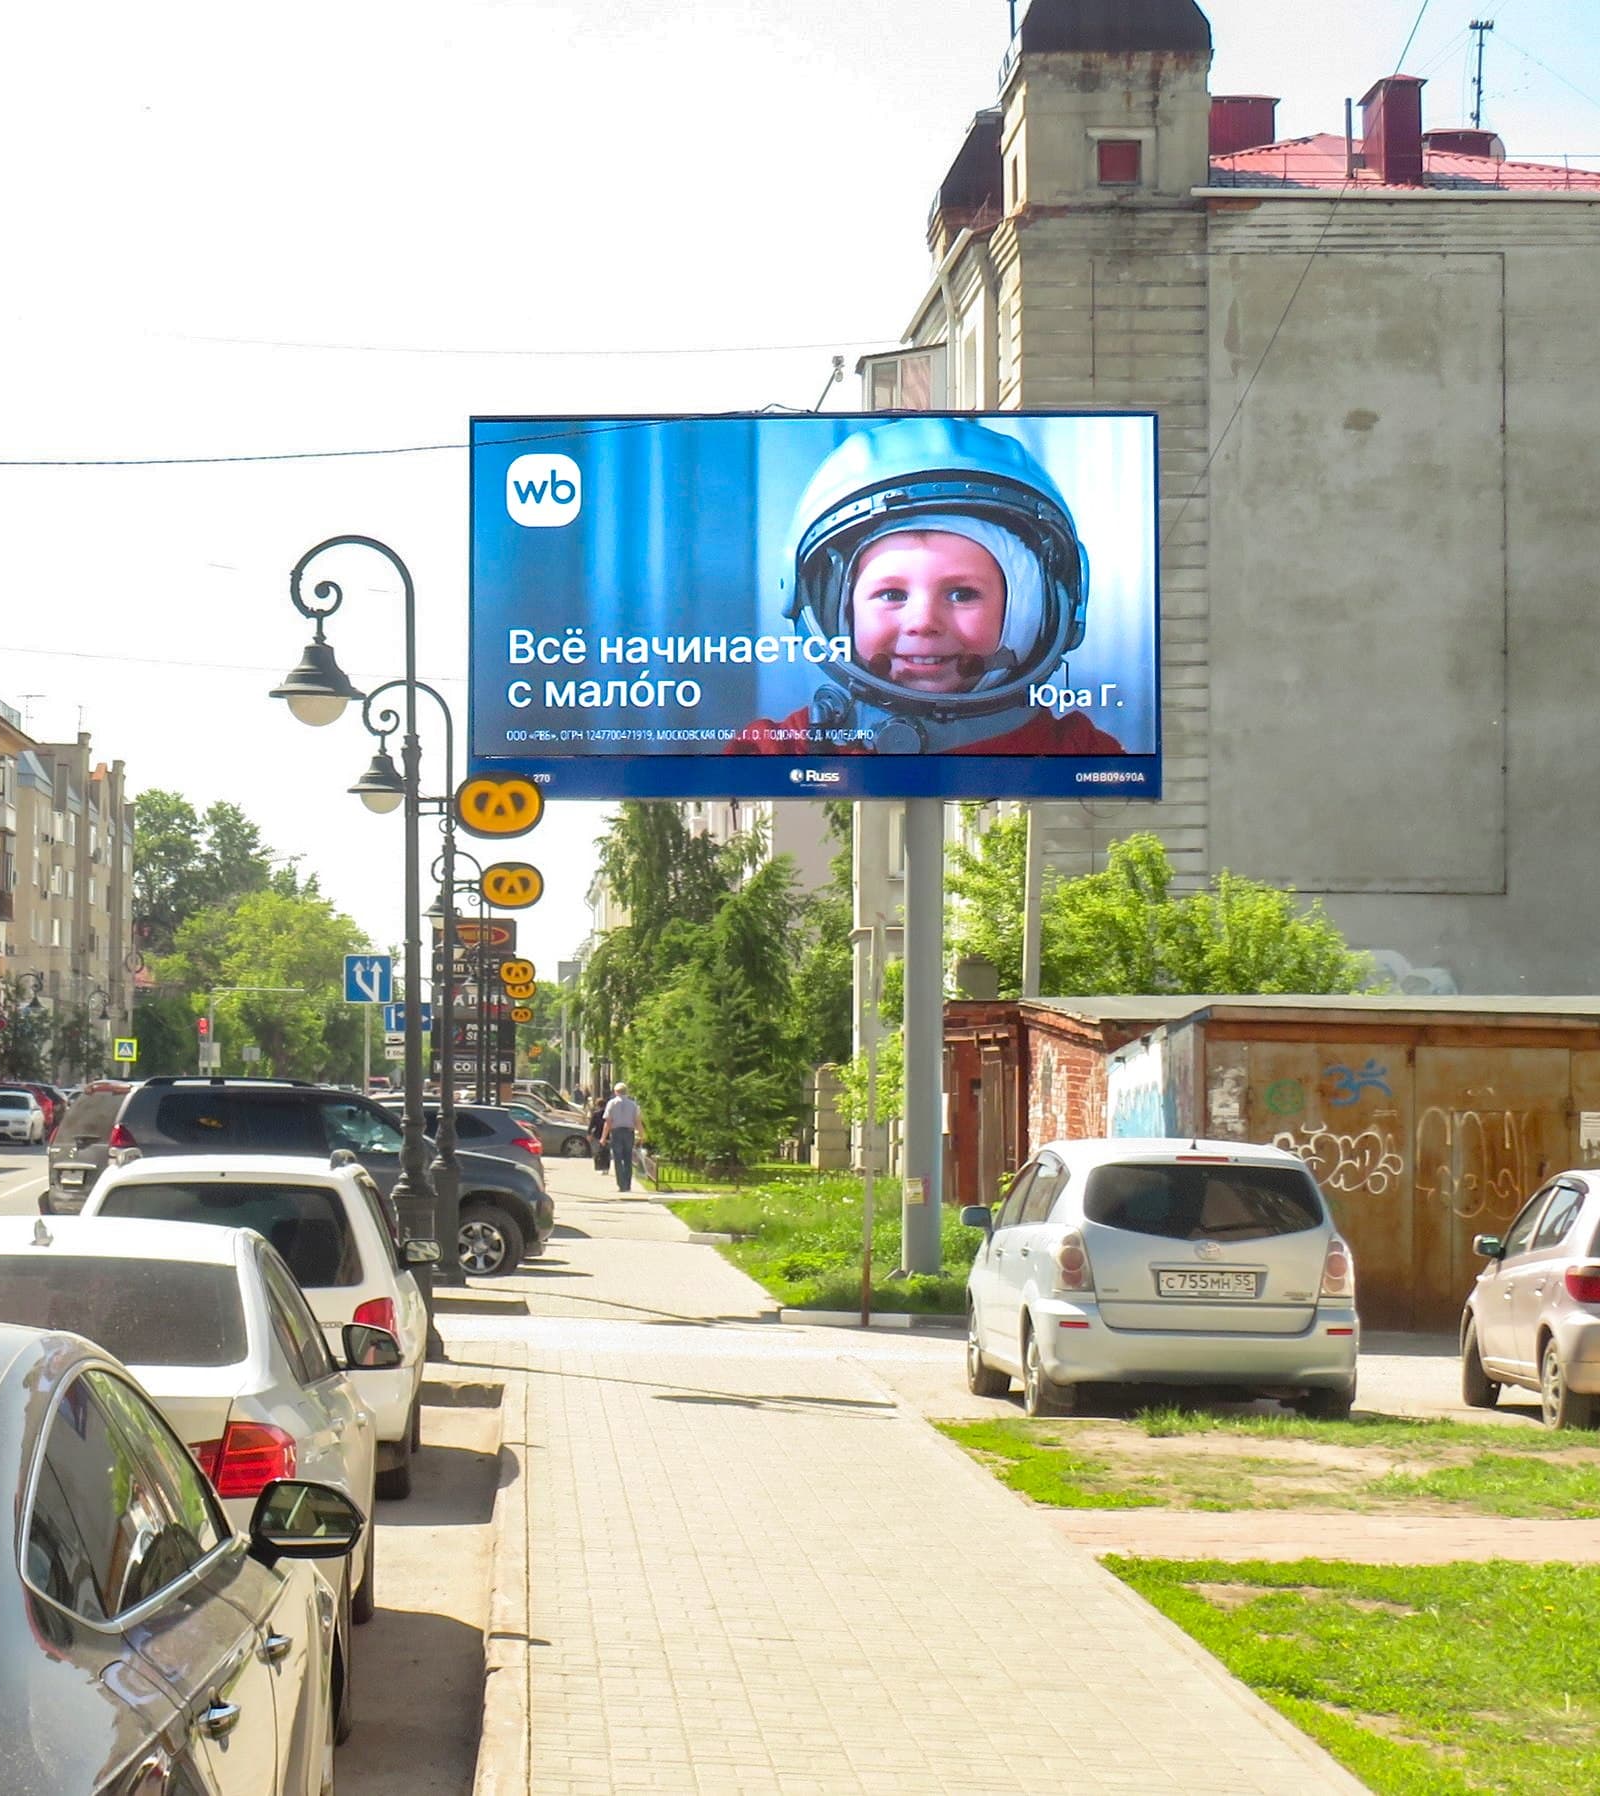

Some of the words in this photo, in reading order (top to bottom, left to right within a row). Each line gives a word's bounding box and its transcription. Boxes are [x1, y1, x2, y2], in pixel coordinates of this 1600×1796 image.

[512, 469, 576, 505] wb
[508, 627, 587, 665] Всё
[600, 635, 852, 664] начинается
[507, 680, 533, 708] с
[1029, 683, 1092, 713] Юра
[1100, 683, 1124, 707] Г.
[506, 729, 527, 742] ООО
[560, 729, 583, 742] ОГРН
[657, 729, 716, 742] МОСКОВСКАЯ
[532, 773, 551, 783] 270
[805, 769, 841, 782] Russ
